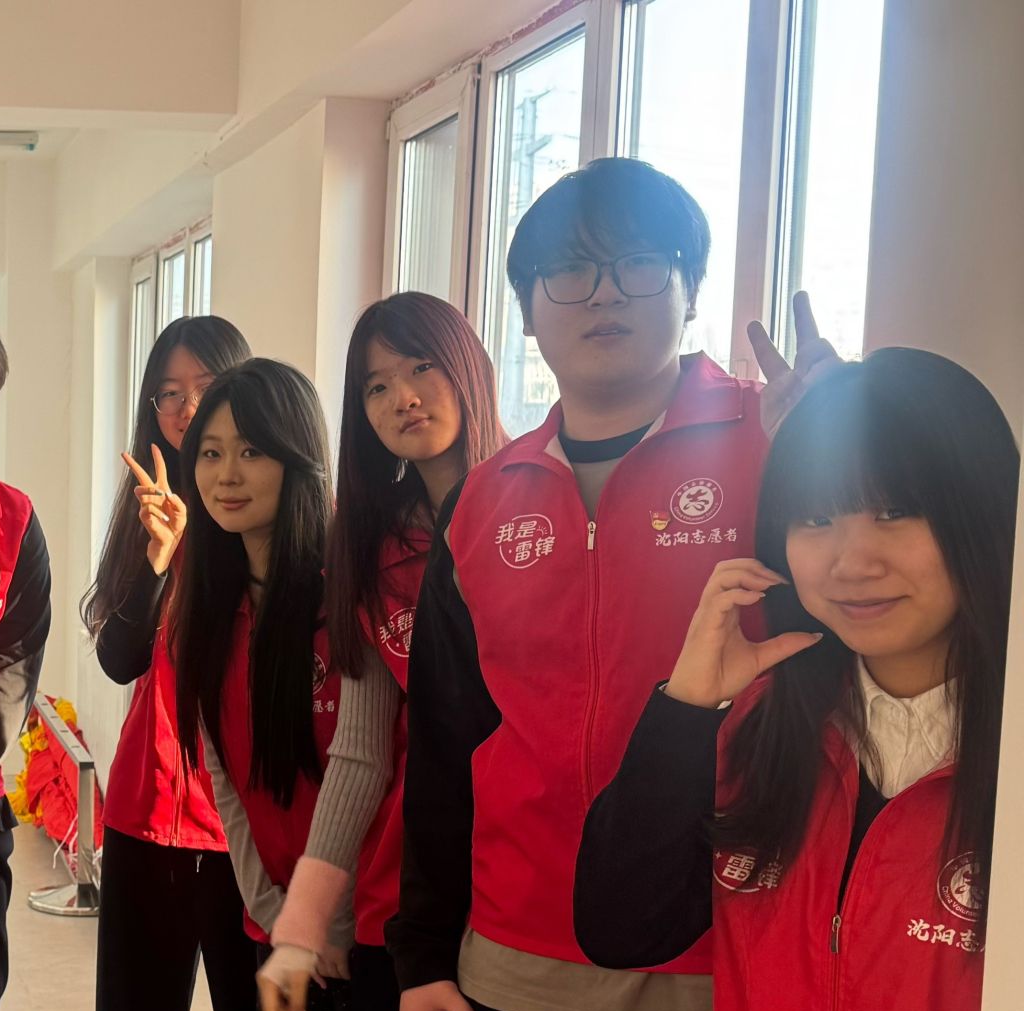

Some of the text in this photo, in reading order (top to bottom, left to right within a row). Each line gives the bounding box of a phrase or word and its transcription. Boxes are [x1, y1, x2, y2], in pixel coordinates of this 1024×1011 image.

[495, 520, 537, 544] 我是
[656, 528, 736, 547] 沈阳志愿者
[515, 536, 556, 562] 雷锋
[907, 919, 985, 952] 沈阳志
